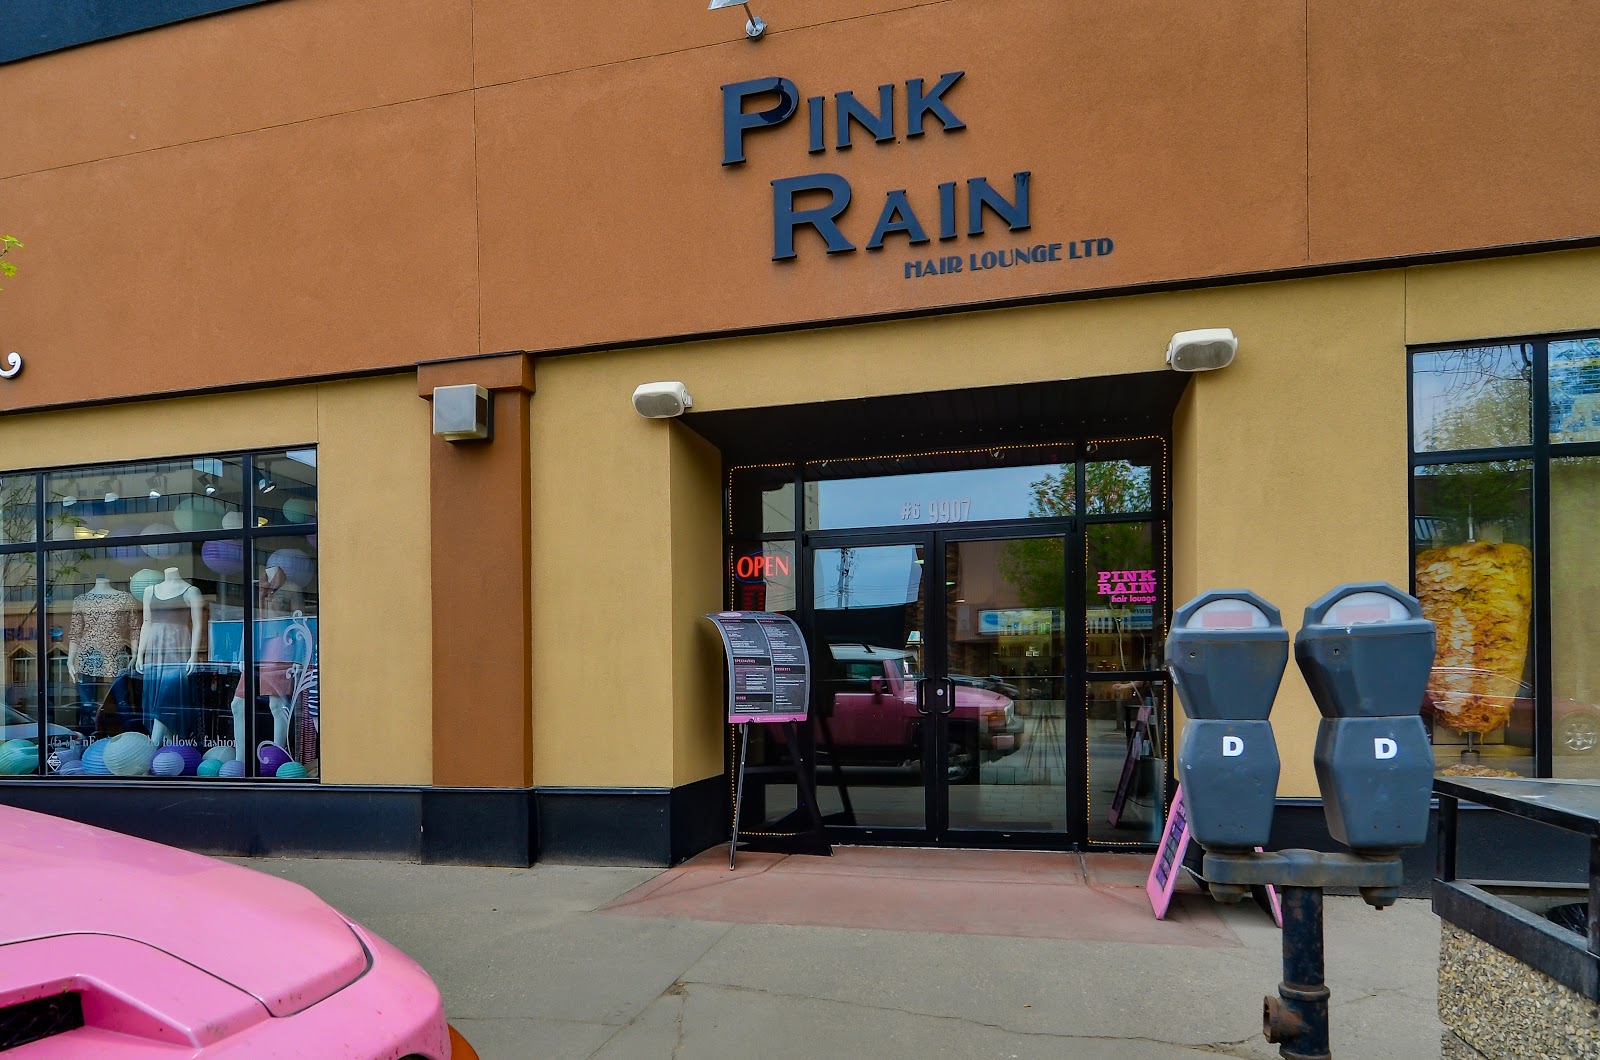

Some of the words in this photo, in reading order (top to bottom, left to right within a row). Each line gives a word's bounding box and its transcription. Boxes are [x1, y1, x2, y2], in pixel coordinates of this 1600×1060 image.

[719, 71, 967, 168] PINK
[769, 171, 1032, 263] RAIN
[904, 255, 964, 280] HAIR
[969, 242, 1063, 272] LOUNGE
[1070, 236, 1115, 260] LTD
[901, 500, 921, 521] #6
[928, 496, 972, 525] 9907
[736, 555, 790, 579] OPEN
[1097, 569, 1157, 583] PINK
[1097, 581, 1158, 595] RAIN
[1111, 594, 1128, 603] hair
[1129, 594, 1157, 604] lounge
[1222, 735, 1245, 757] D
[1374, 737, 1398, 760] D
